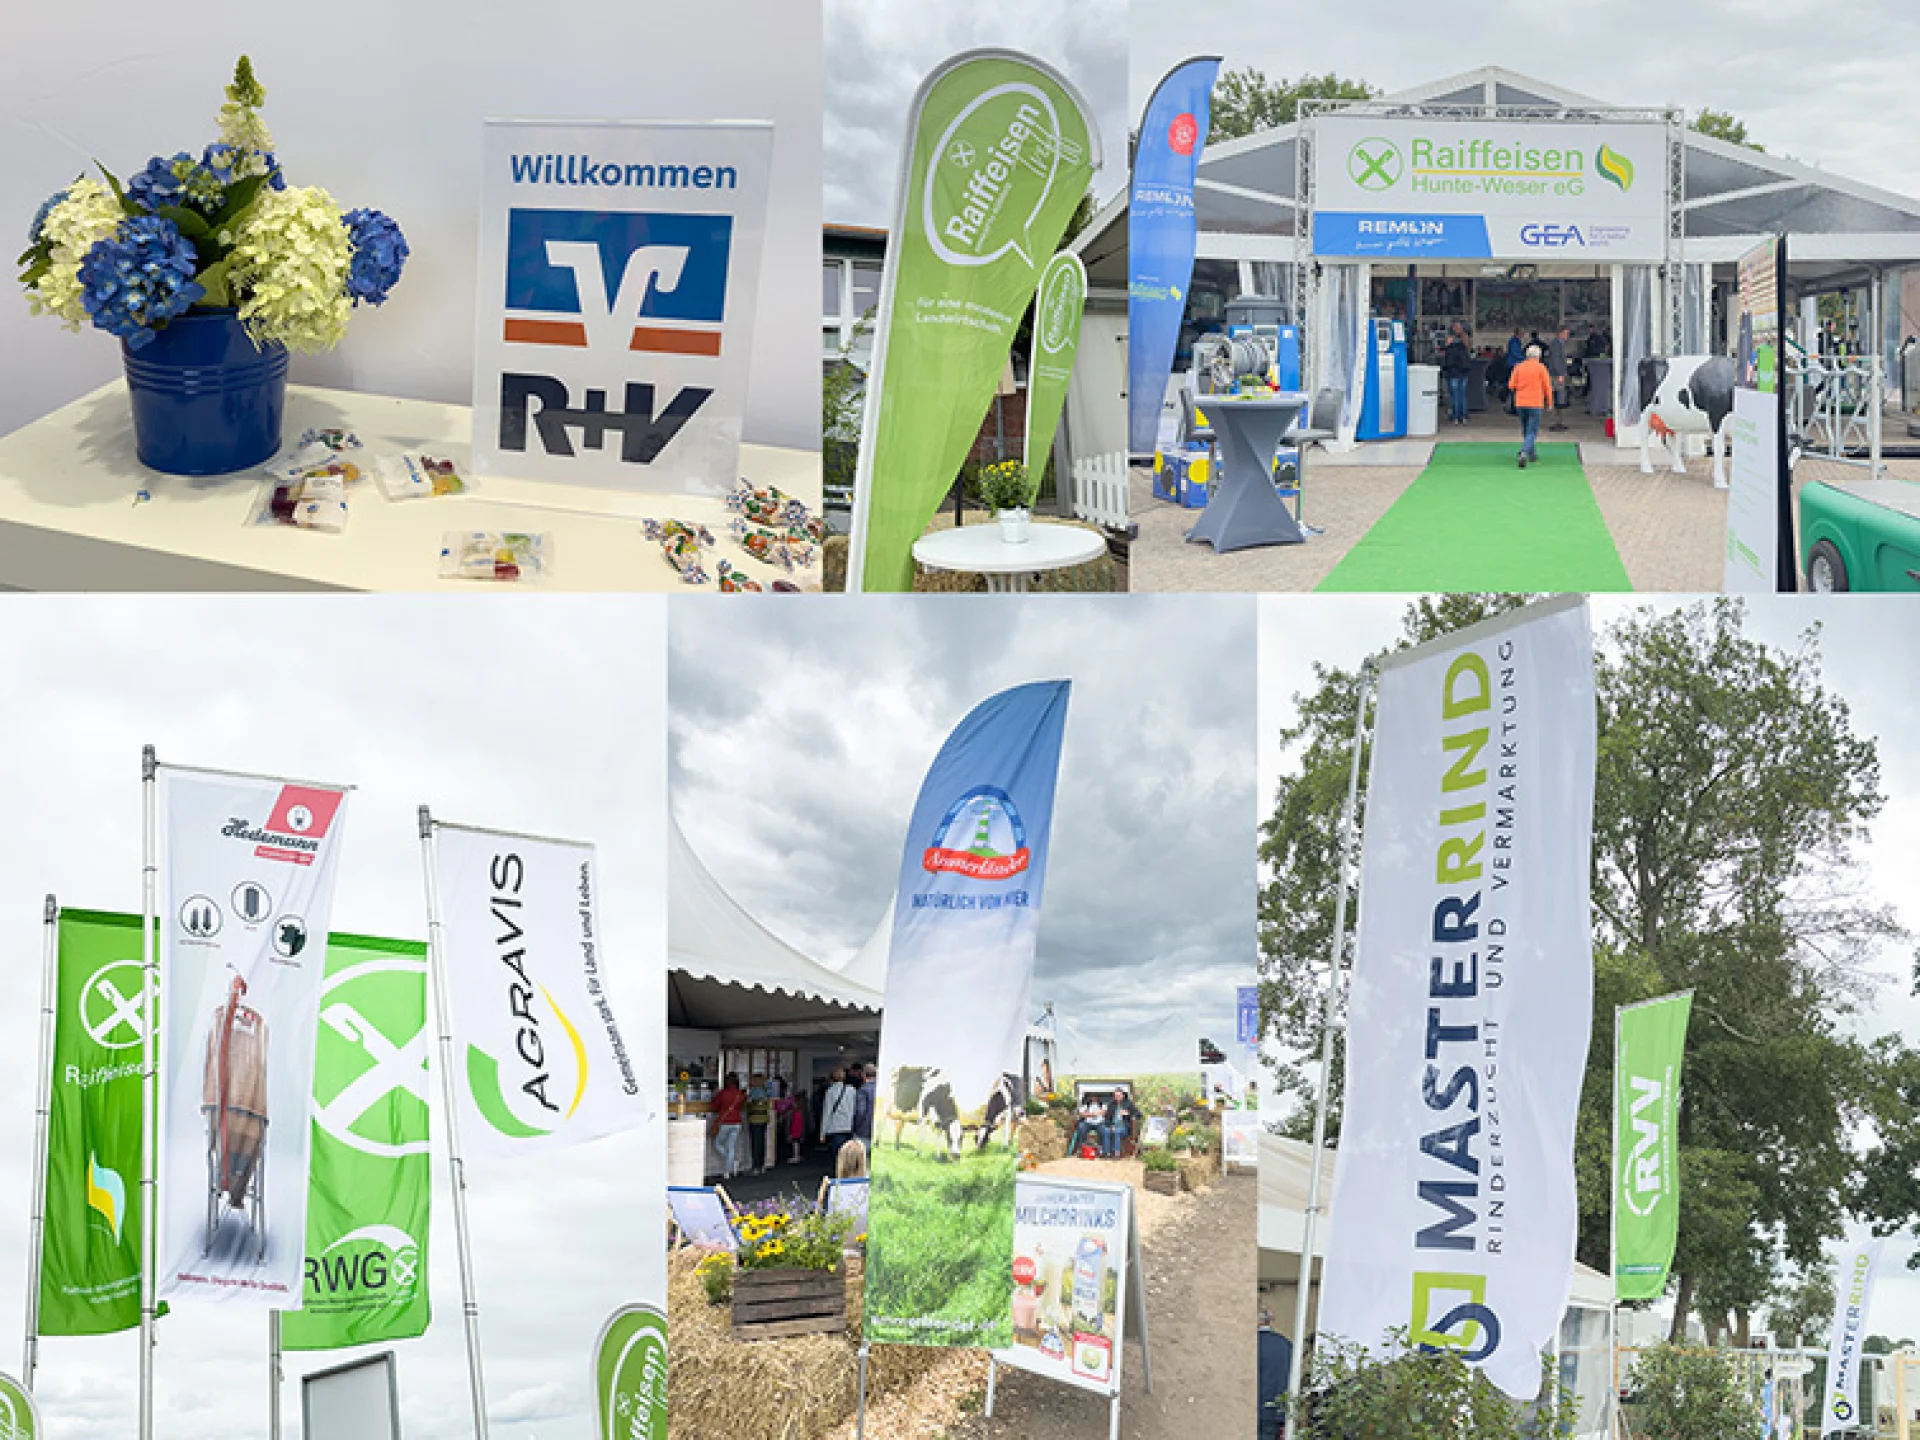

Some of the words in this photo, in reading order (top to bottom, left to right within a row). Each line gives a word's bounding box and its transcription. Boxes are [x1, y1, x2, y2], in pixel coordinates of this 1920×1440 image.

[510, 154, 738, 190] Willkommen
[944, 103, 1040, 246] Raiffeisen
[1411, 138, 1584, 172] Raiffeisen
[1411, 177, 1550, 195] Hunte-Weser
[1554, 178, 1585, 196] eG
[1520, 224, 1586, 248] GEA
[500, 371, 716, 466] R+V
[1491, 640, 1517, 890] VERMARKTUNG
[579, 909, 593, 938] und
[1415, 652, 1491, 1251] MASTERRIND
[580, 940, 598, 974] Land
[1485, 918, 1507, 988] UND
[490, 853, 560, 1112] AGRAVIS
[1484, 1018, 1507, 1253] RINDERZUCHT
[304, 1251, 387, 1293] RWG
